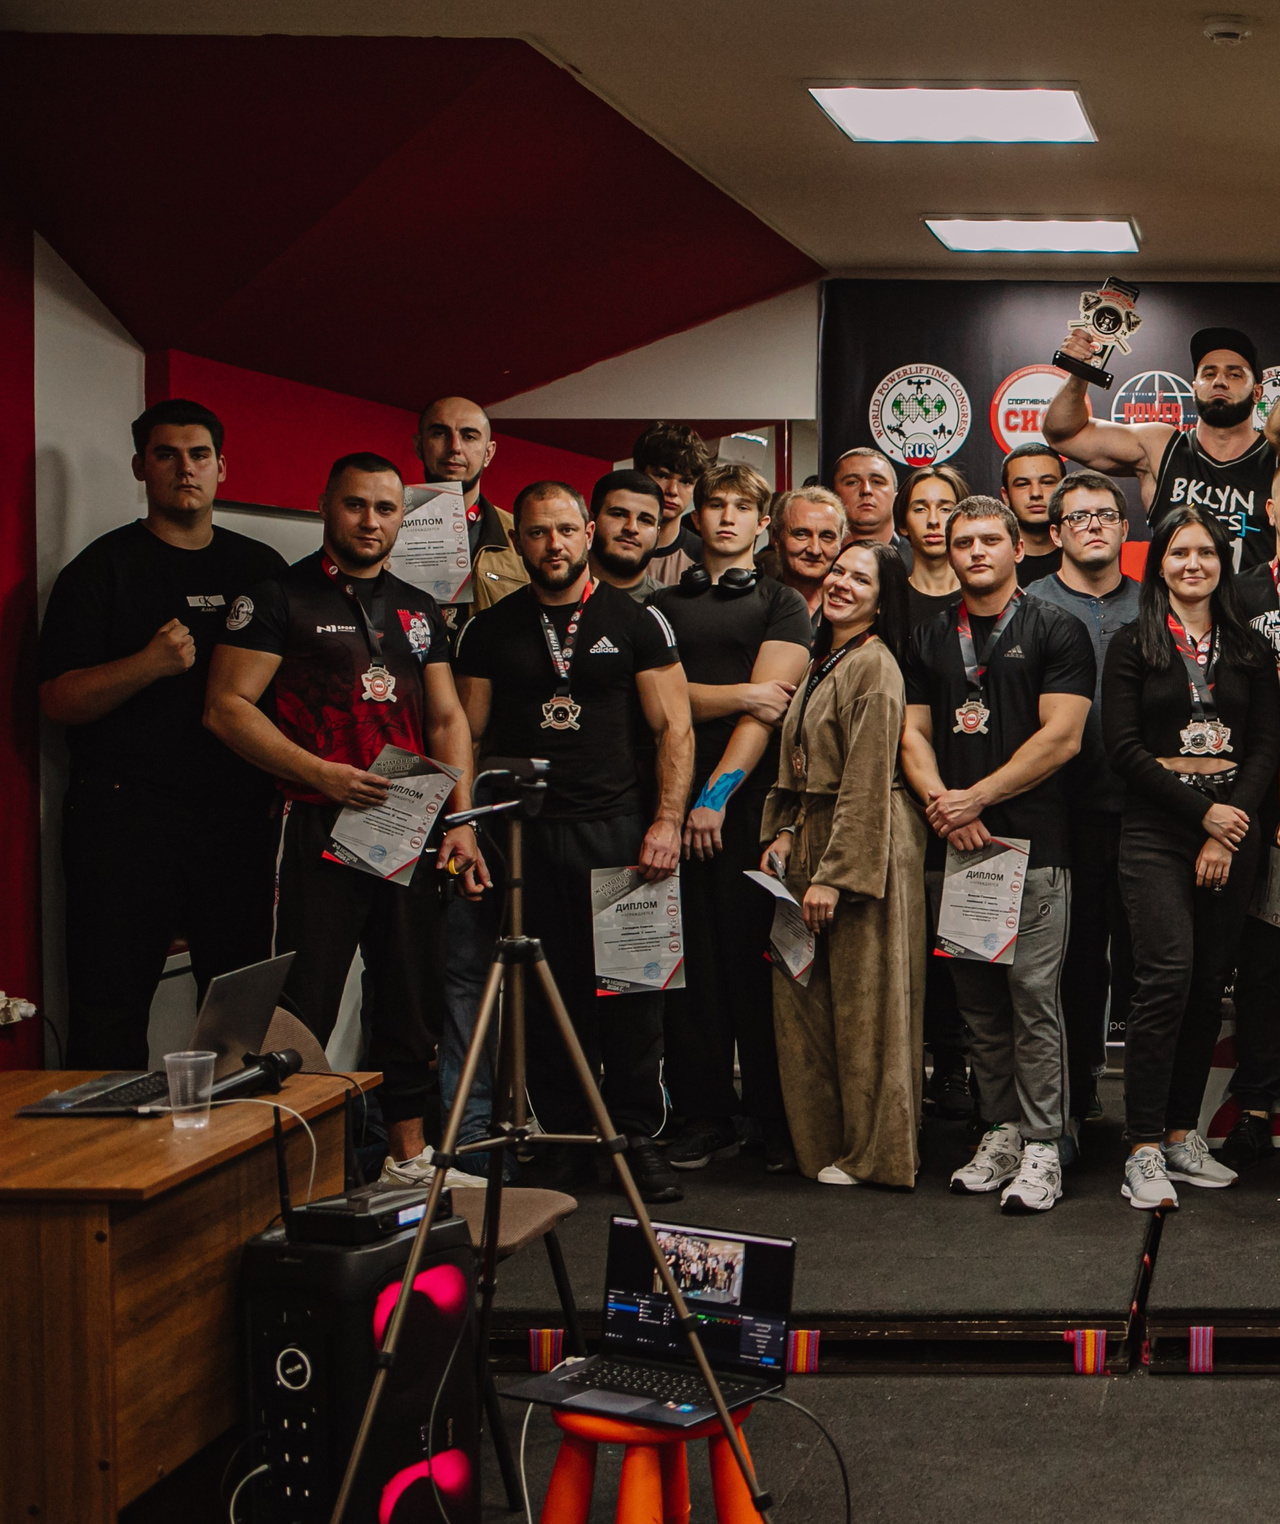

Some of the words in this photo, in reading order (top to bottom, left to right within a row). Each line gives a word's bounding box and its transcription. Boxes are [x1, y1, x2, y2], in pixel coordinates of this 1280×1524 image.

[877, 366, 950, 397] POWERLIFTING
[872, 398, 883, 439] WORLD
[950, 382, 969, 438] CONGRESS
[1124, 402, 1182, 423] POWER
[905, 443, 935, 458] RUS
[1170, 477, 1255, 516] BKLYN
[400, 517, 443, 529] ДИПЛОМ
[966, 870, 1004, 881] ДИПЛОМ
[615, 900, 658, 913] ДИПЛОМ
